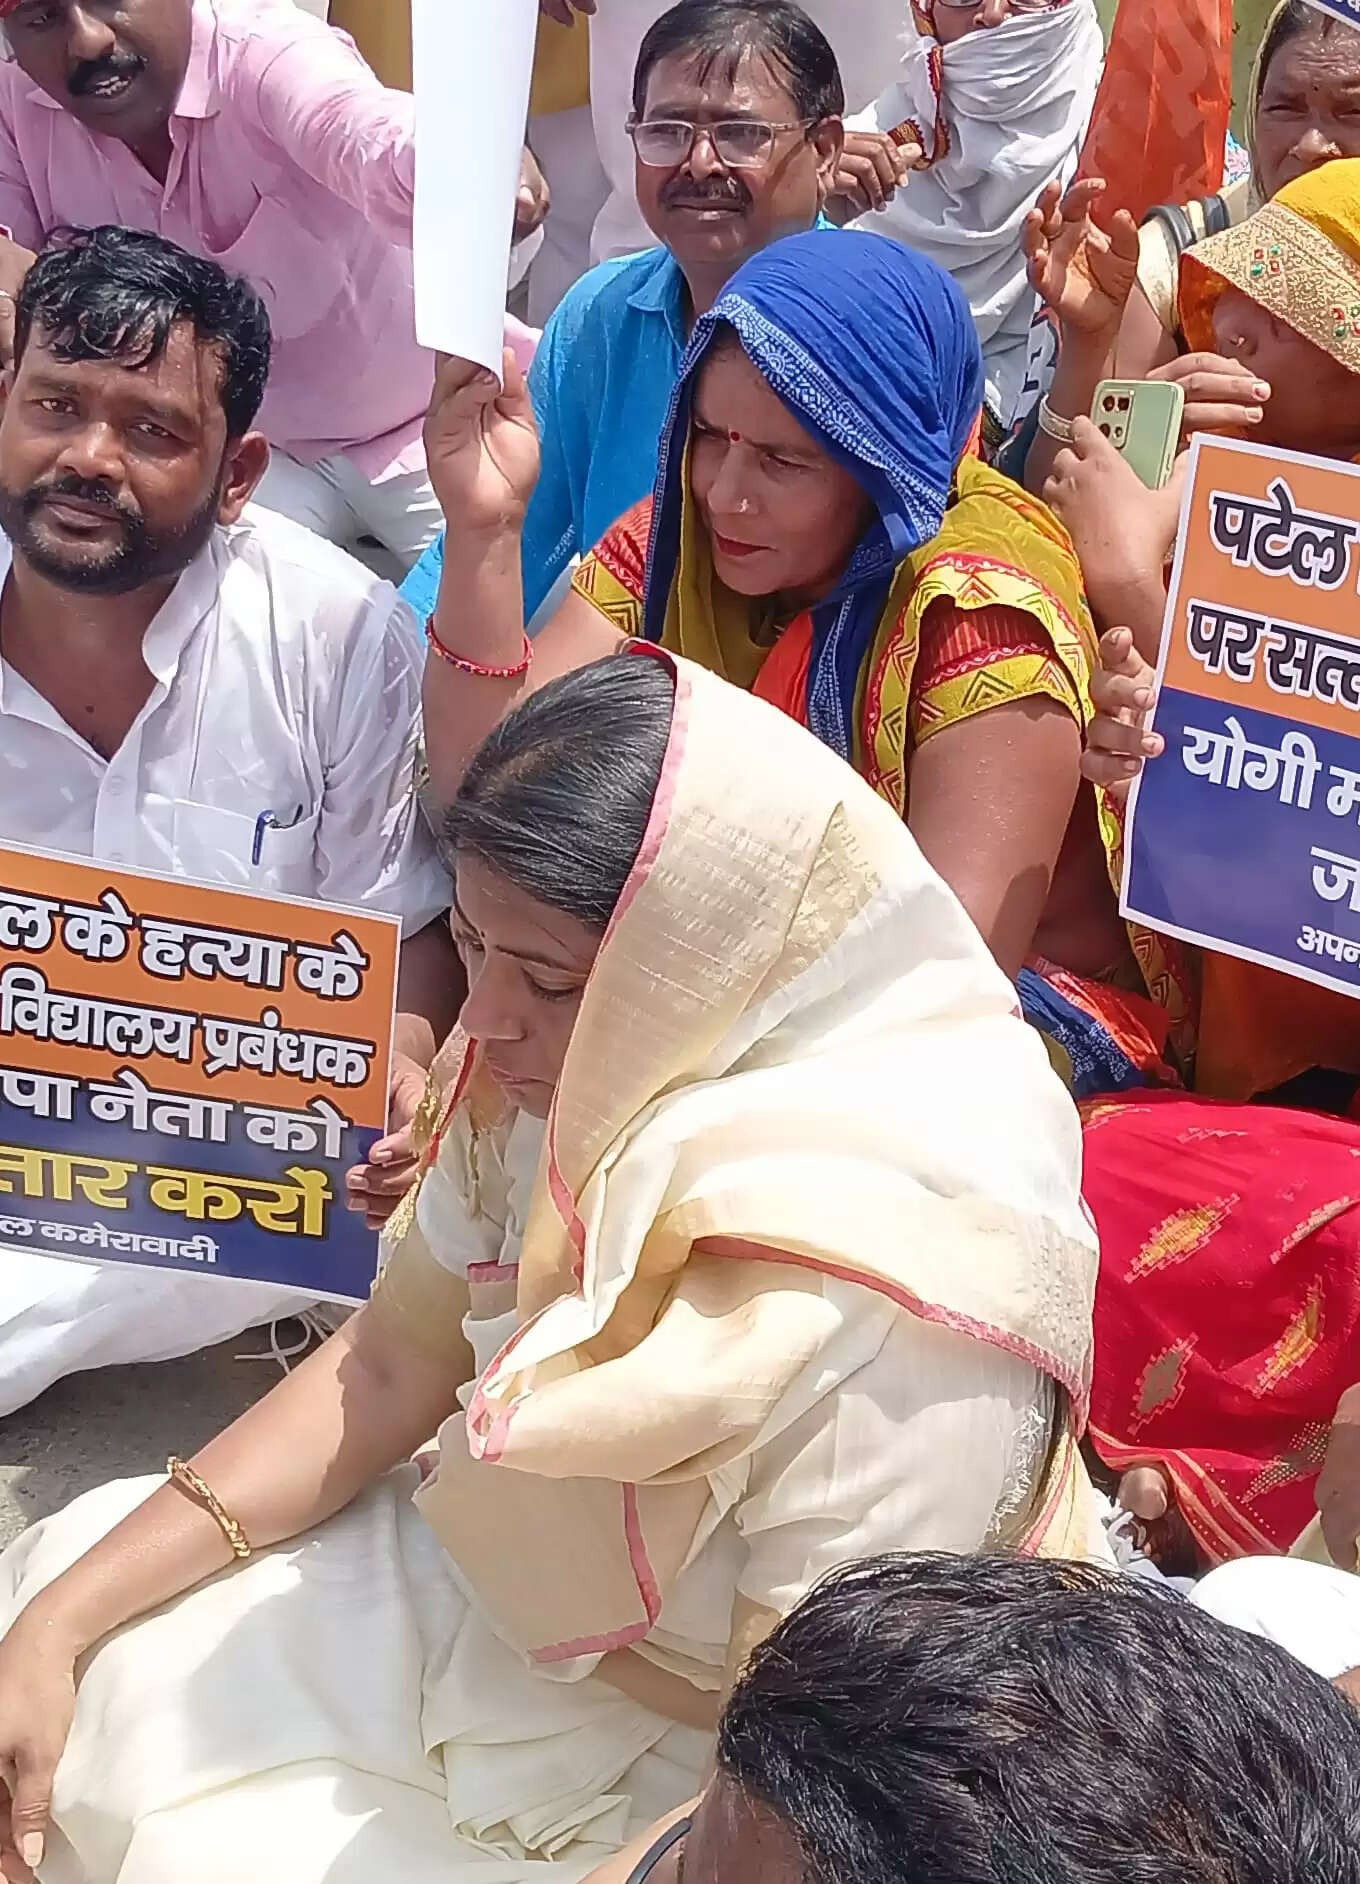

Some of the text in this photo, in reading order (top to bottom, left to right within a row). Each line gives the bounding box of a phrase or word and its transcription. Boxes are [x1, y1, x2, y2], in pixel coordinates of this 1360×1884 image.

[1210, 478, 1355, 587] पटेल
[1187, 602, 1266, 682] पर
[1182, 719, 1324, 809] योगी
[61, 892, 132, 959] के
[143, 920, 289, 989] हत्या
[297, 934, 366, 998] के
[0, 967, 195, 1060] विद्यालय
[203, 1010, 374, 1085] प्रबंधक
[90, 1070, 233, 1143] नेता
[244, 1100, 348, 1158] को
[41, 1217, 219, 1263] कमेरावादी
